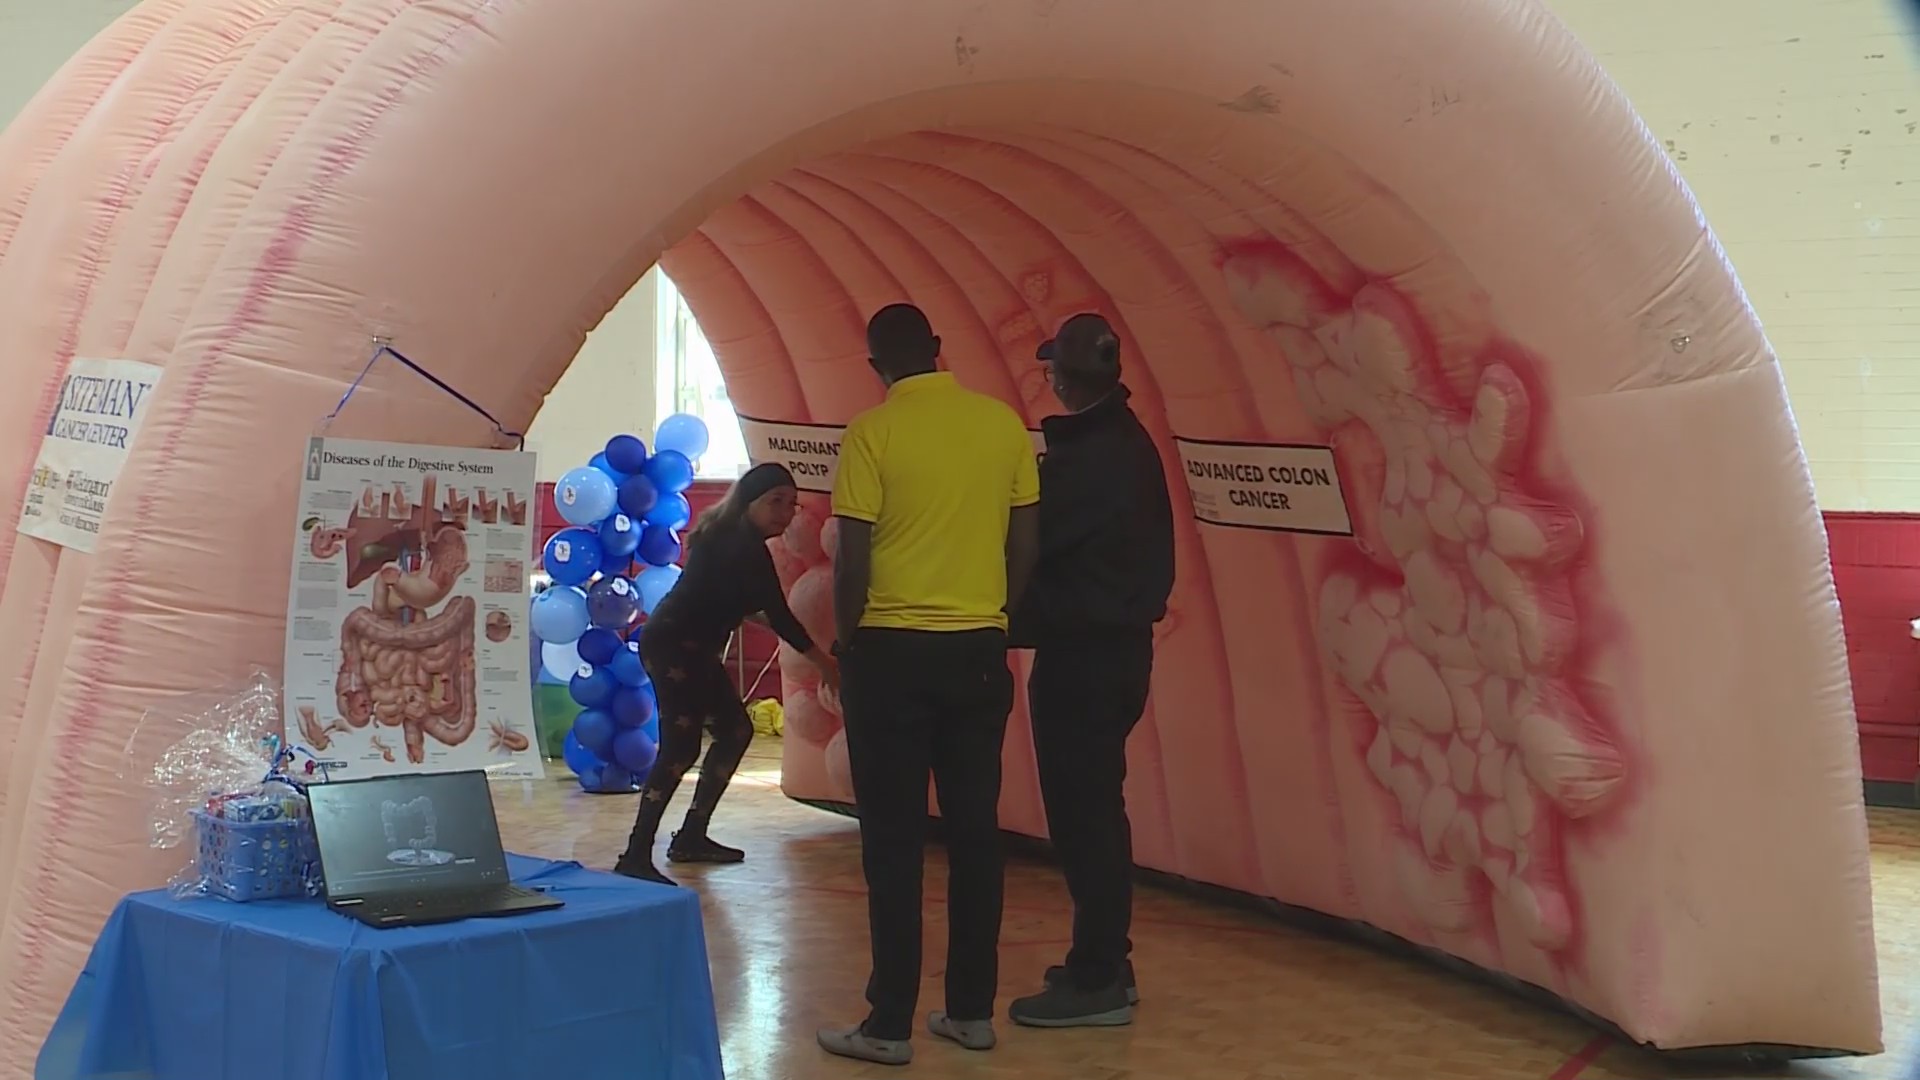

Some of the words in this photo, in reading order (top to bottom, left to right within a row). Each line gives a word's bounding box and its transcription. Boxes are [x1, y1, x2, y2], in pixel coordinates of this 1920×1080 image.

[64, 375, 146, 419] SITEMAN
[55, 418, 89, 442] CANCER
[87, 423, 128, 449] CENTER
[323, 452, 370, 467] Diseases
[373, 455, 387, 467] of
[387, 456, 405, 468] the
[408, 457, 455, 473] Digestive
[457, 461, 494, 476] System
[789, 461, 829, 477] POLYP
[1187, 460, 1264, 483] ADVANCED
[1268, 467, 1330, 486] COLON
[1229, 490, 1292, 510] CANCER
